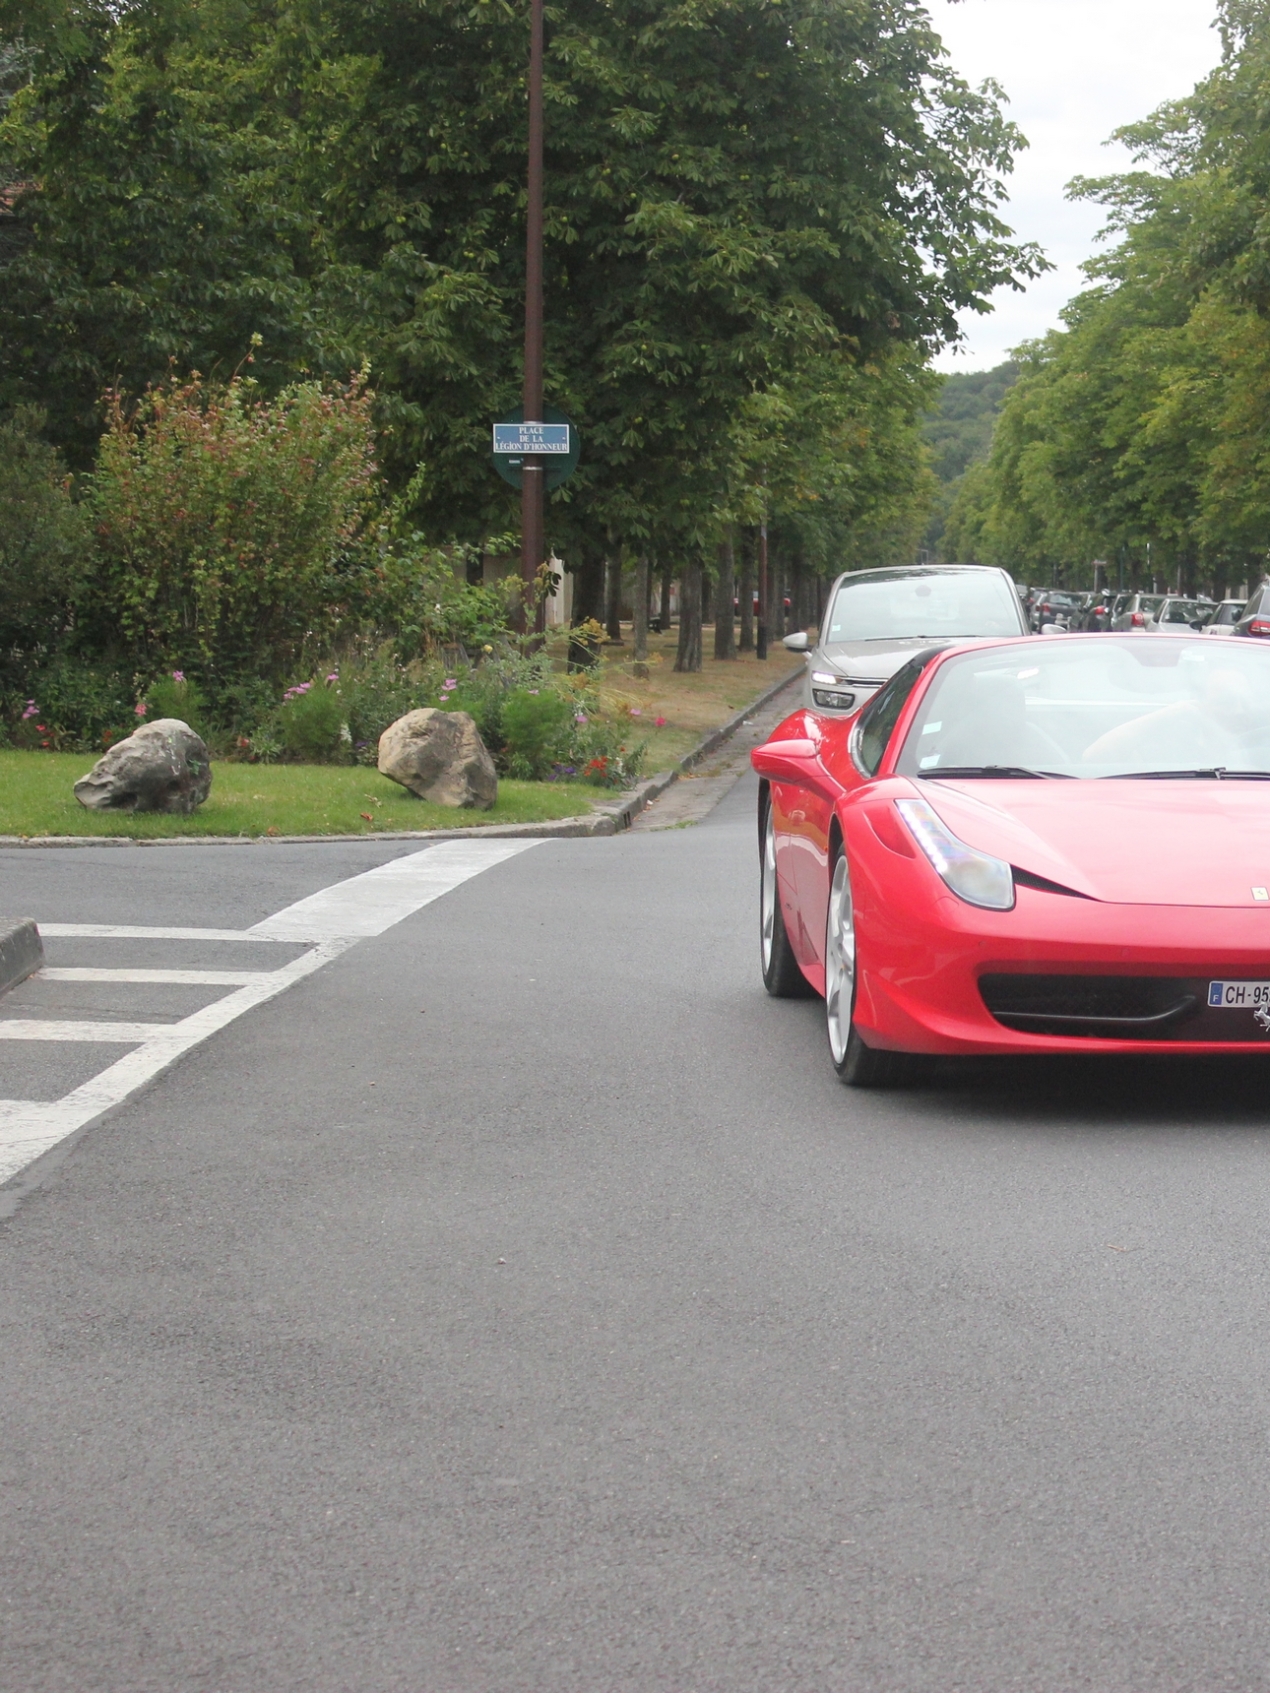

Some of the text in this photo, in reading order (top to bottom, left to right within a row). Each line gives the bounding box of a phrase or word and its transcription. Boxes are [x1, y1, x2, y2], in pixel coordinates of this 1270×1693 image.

[519, 426, 544, 435] PLACE
[519, 434, 544, 443] DE LA
[523, 442, 567, 451] D'HONNEUR
[1212, 994, 1219, 1003] F
